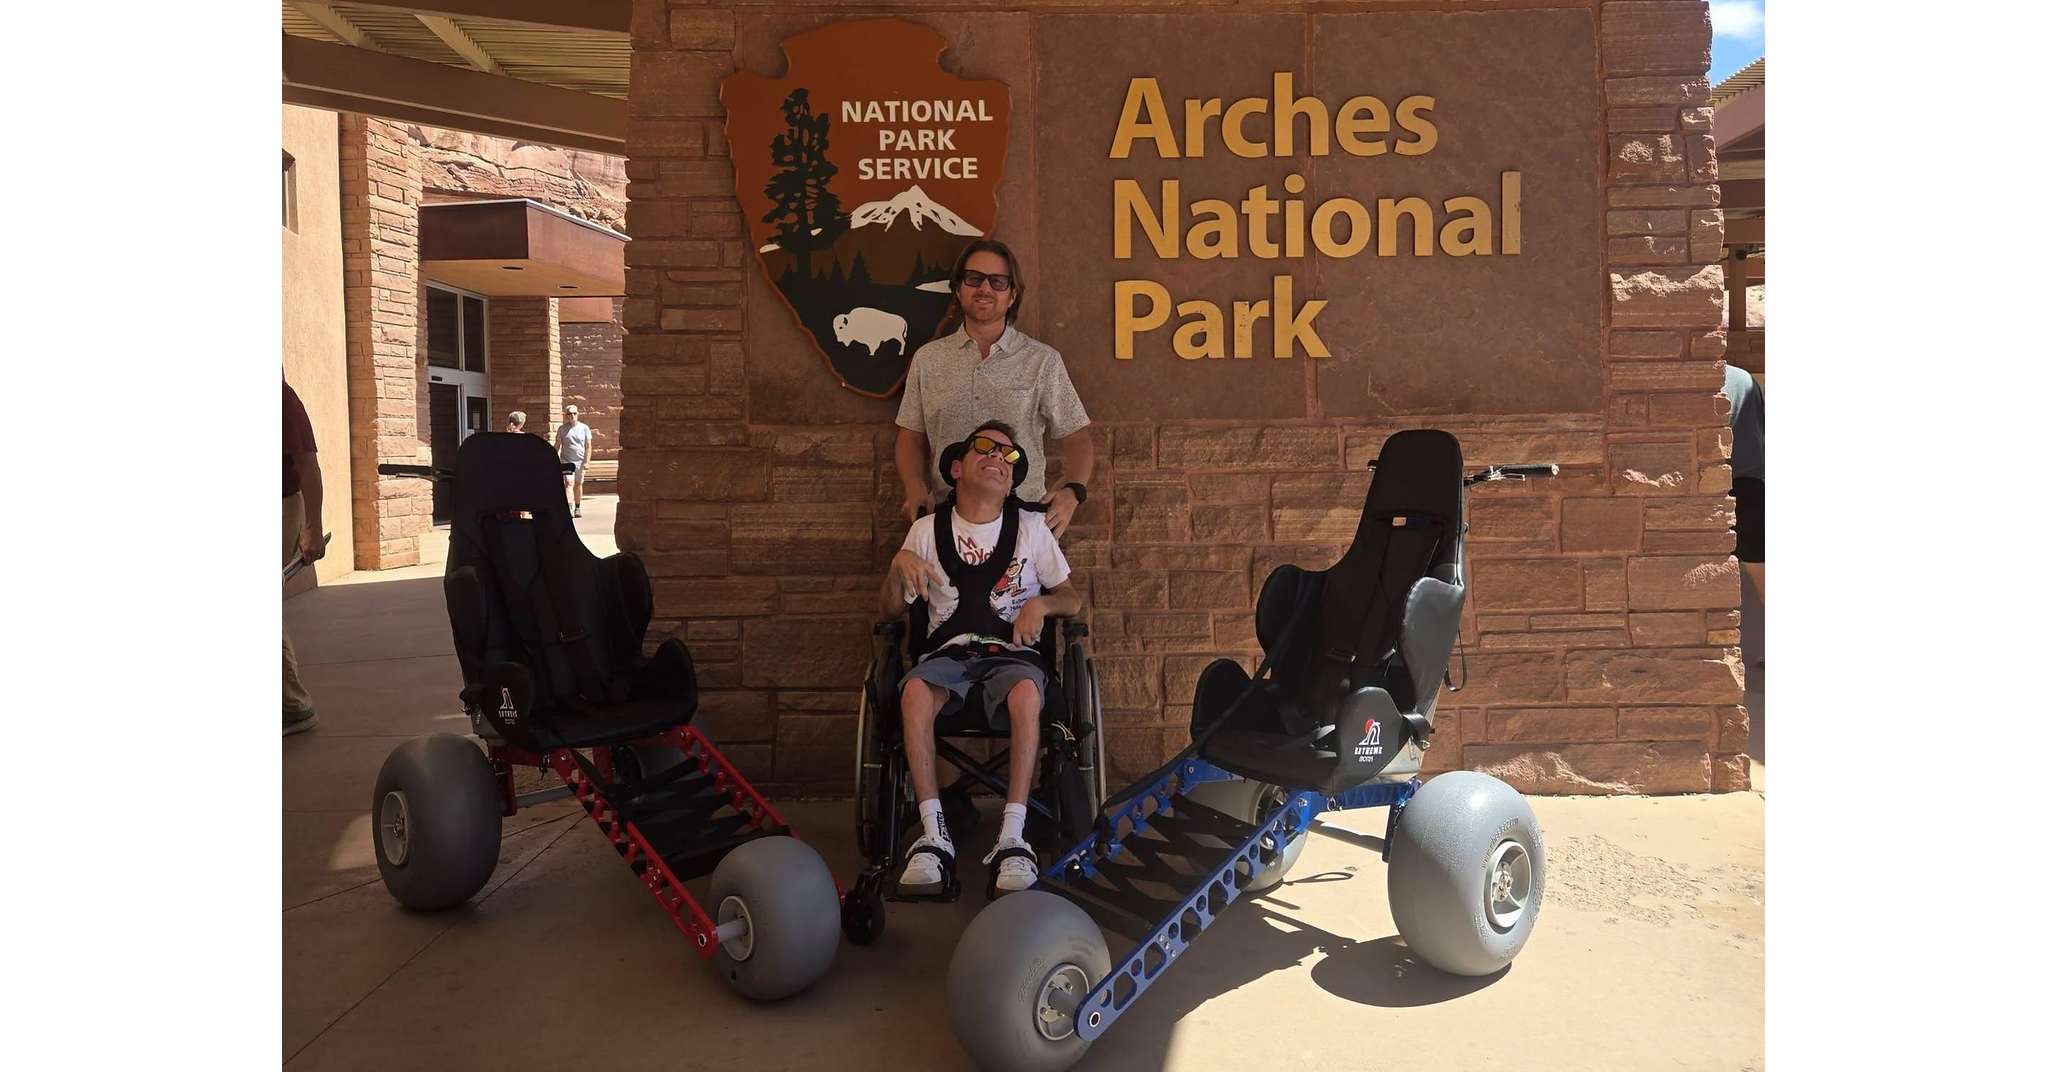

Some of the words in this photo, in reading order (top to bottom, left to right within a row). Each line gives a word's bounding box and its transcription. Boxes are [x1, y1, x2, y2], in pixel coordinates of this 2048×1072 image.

[841, 100, 993, 123] NATIONAL
[1109, 72, 1438, 158] Arches
[879, 129, 956, 151] PARK
[858, 157, 978, 180] SERVICE
[1114, 171, 1521, 259] National
[1114, 275, 1332, 360] Park
[1354, 746, 1383, 755] EXTREME
